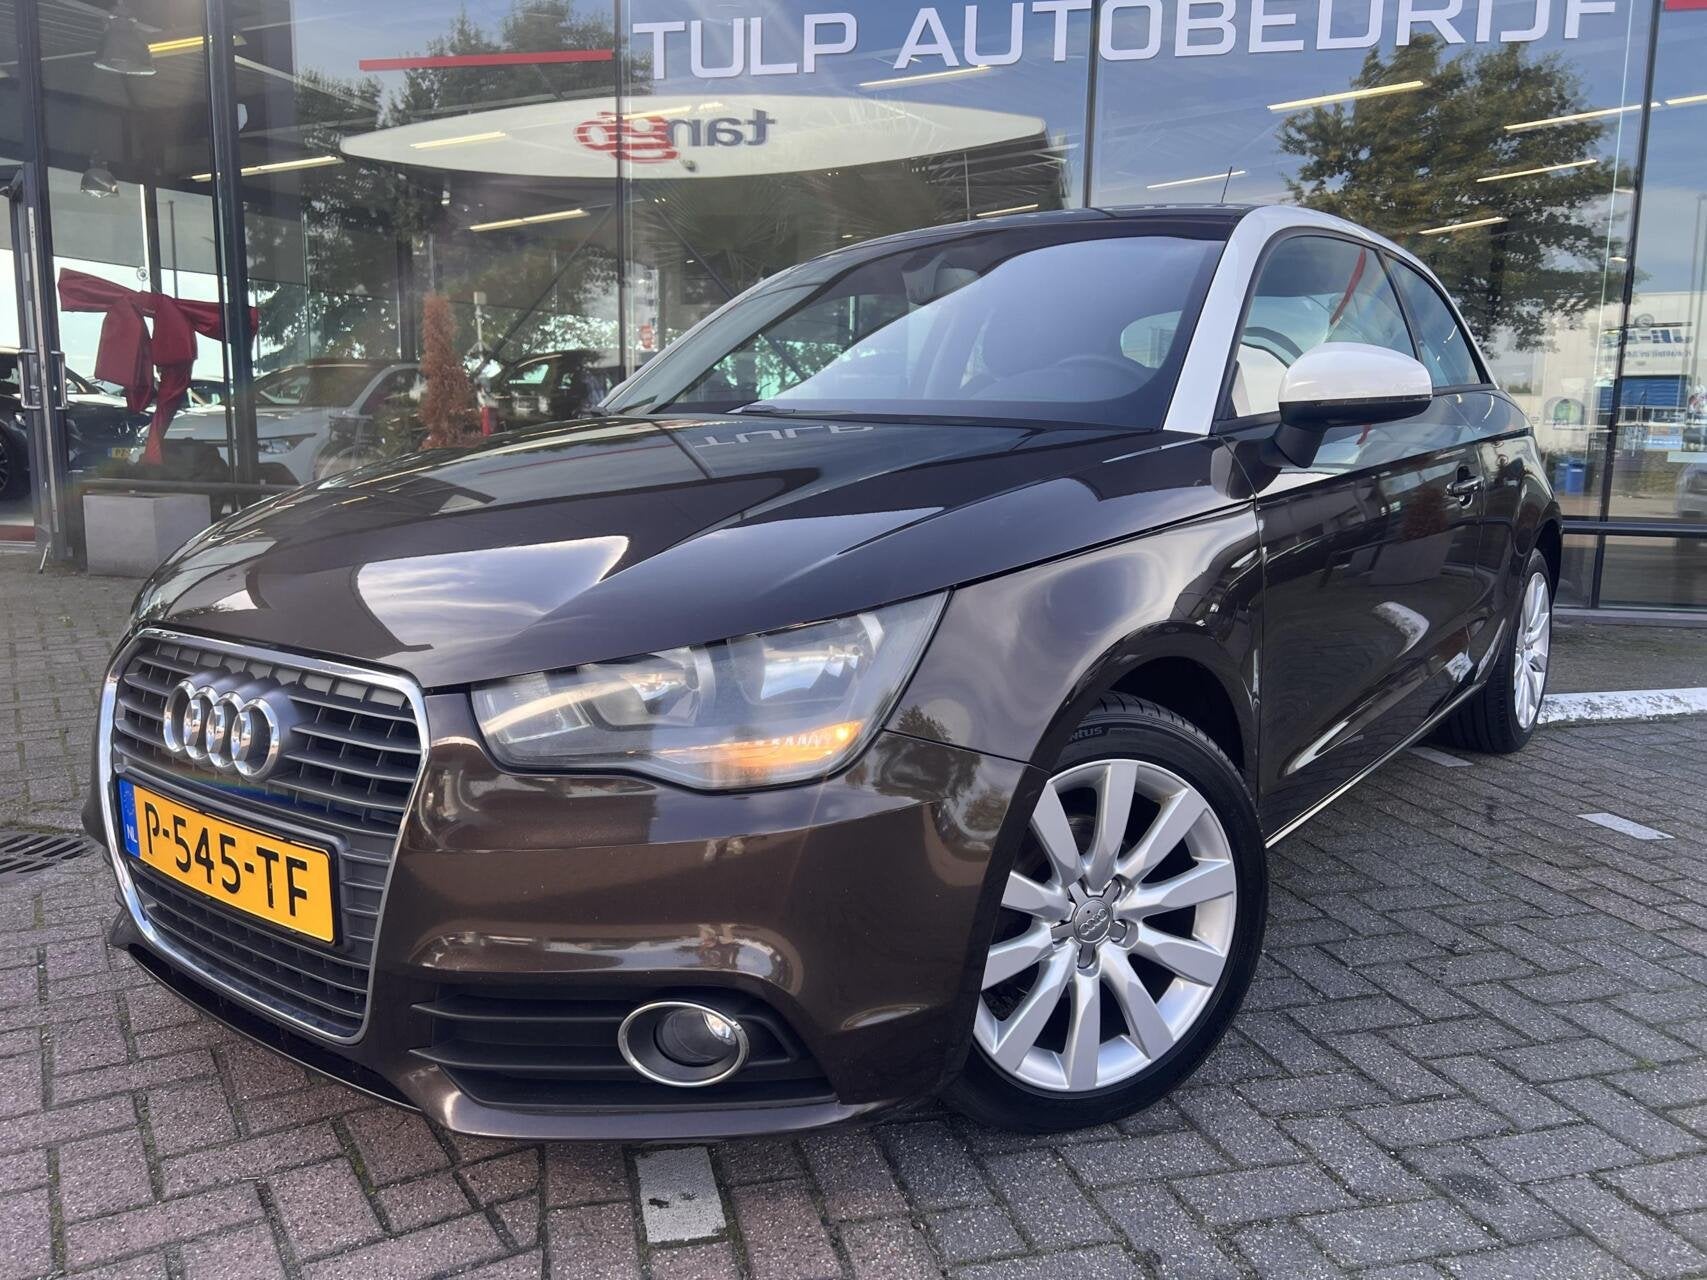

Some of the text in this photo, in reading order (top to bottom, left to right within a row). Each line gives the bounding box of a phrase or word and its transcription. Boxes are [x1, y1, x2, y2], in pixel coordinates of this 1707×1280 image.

[632, 0, 1617, 80] TULP AUTOBEDRIJF
[126, 823, 138, 843] NL
[144, 801, 308, 917] P-545-TF
